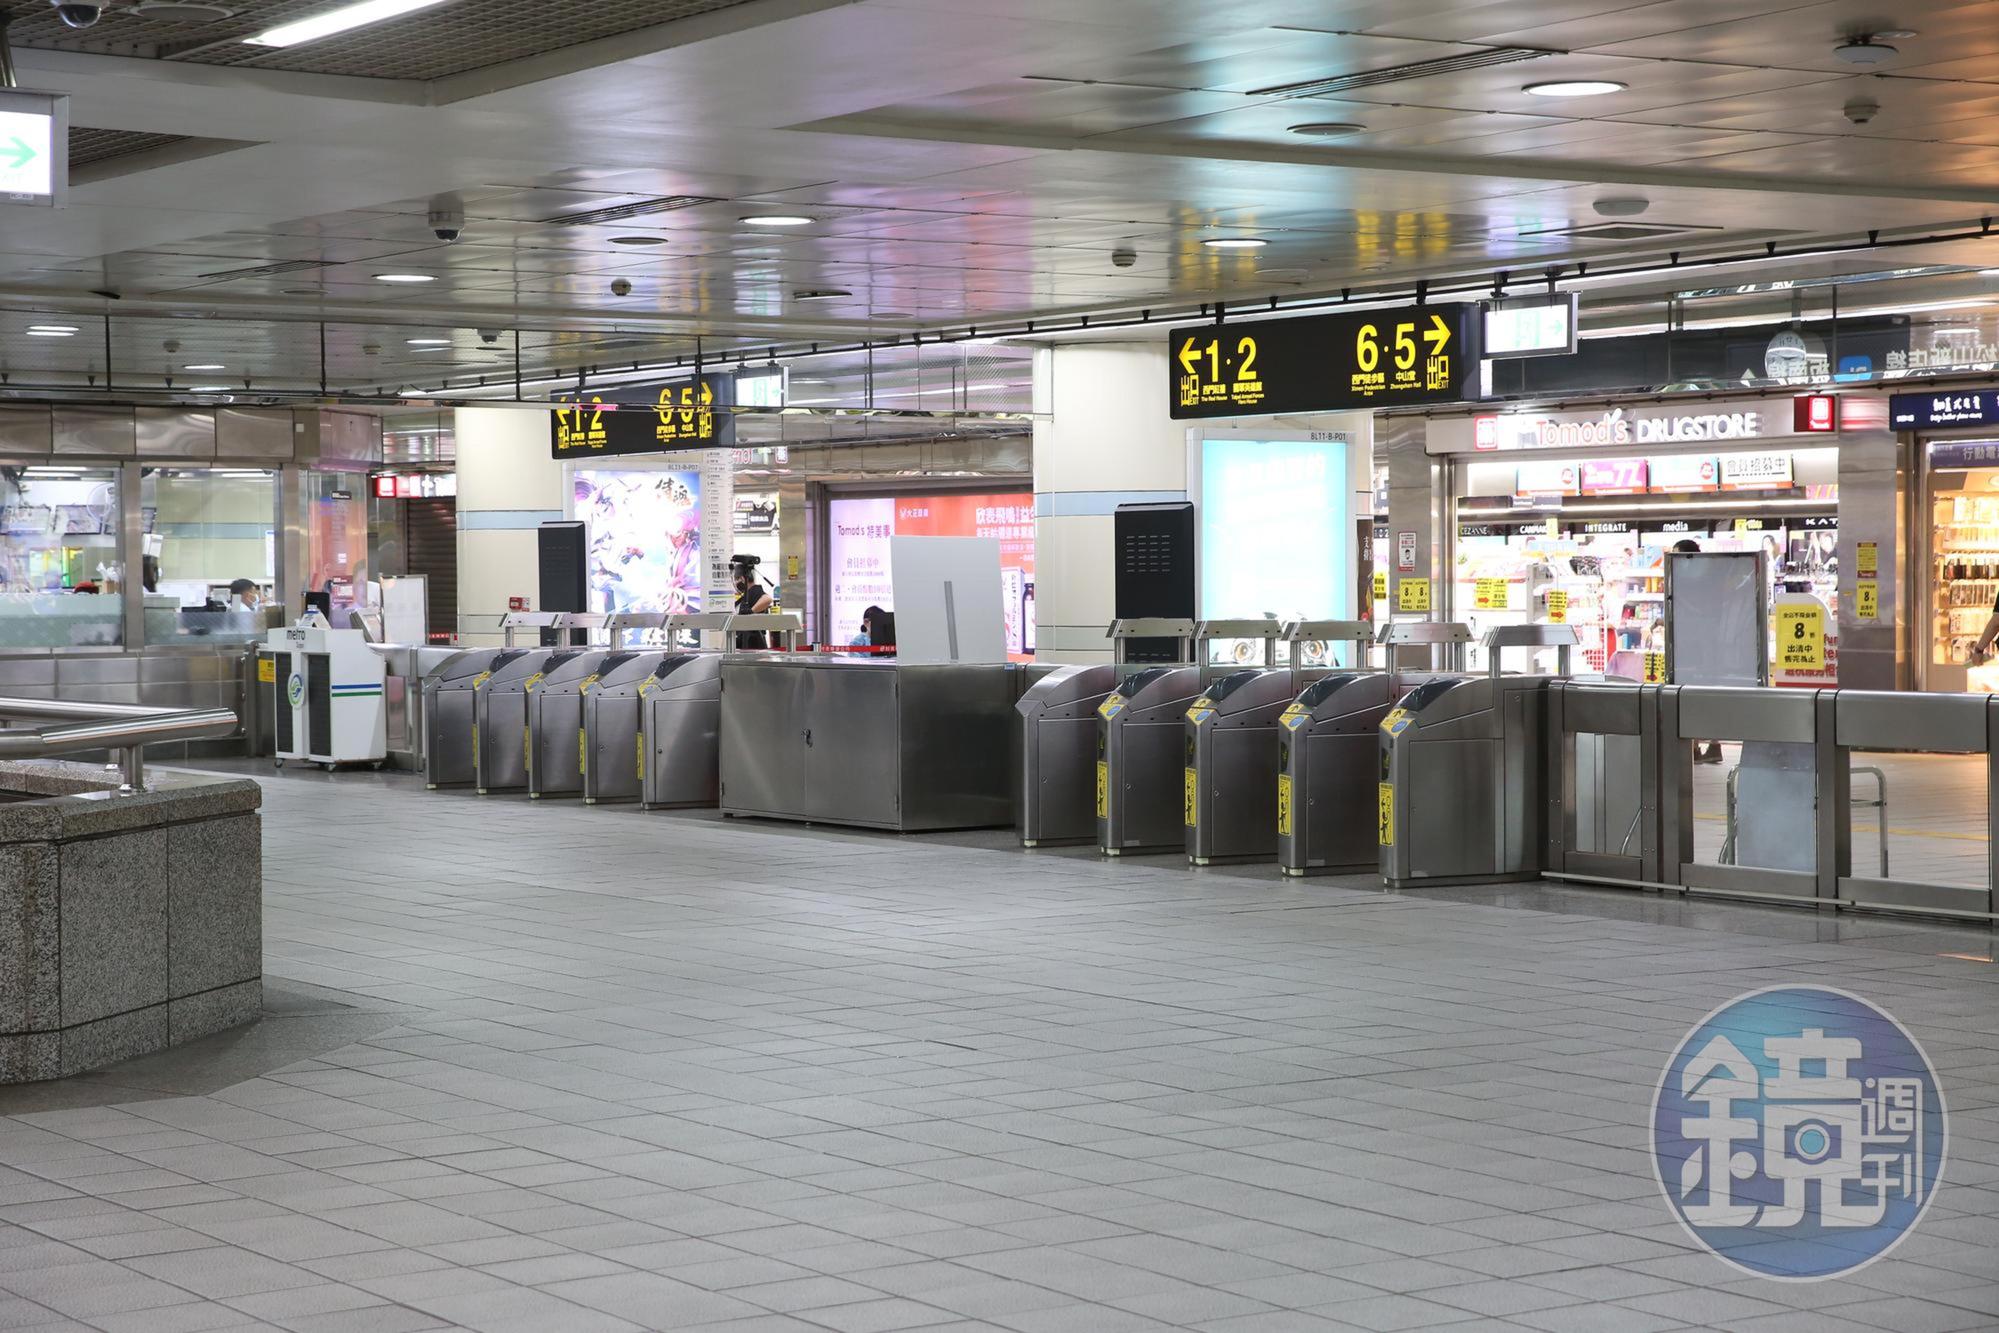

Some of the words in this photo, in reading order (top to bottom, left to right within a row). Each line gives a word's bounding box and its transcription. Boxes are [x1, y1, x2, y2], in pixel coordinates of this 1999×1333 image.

[1536, 407, 1630, 446] Tomod's
[1636, 412, 1758, 442] DRUGSTORE
[1585, 522, 1627, 533] INTEGRATE
[1662, 520, 1689, 532] media
[1805, 517, 1838, 527] KAT
[1794, 622, 1805, 640] 8
[1787, 644, 1813, 653] 出清中
